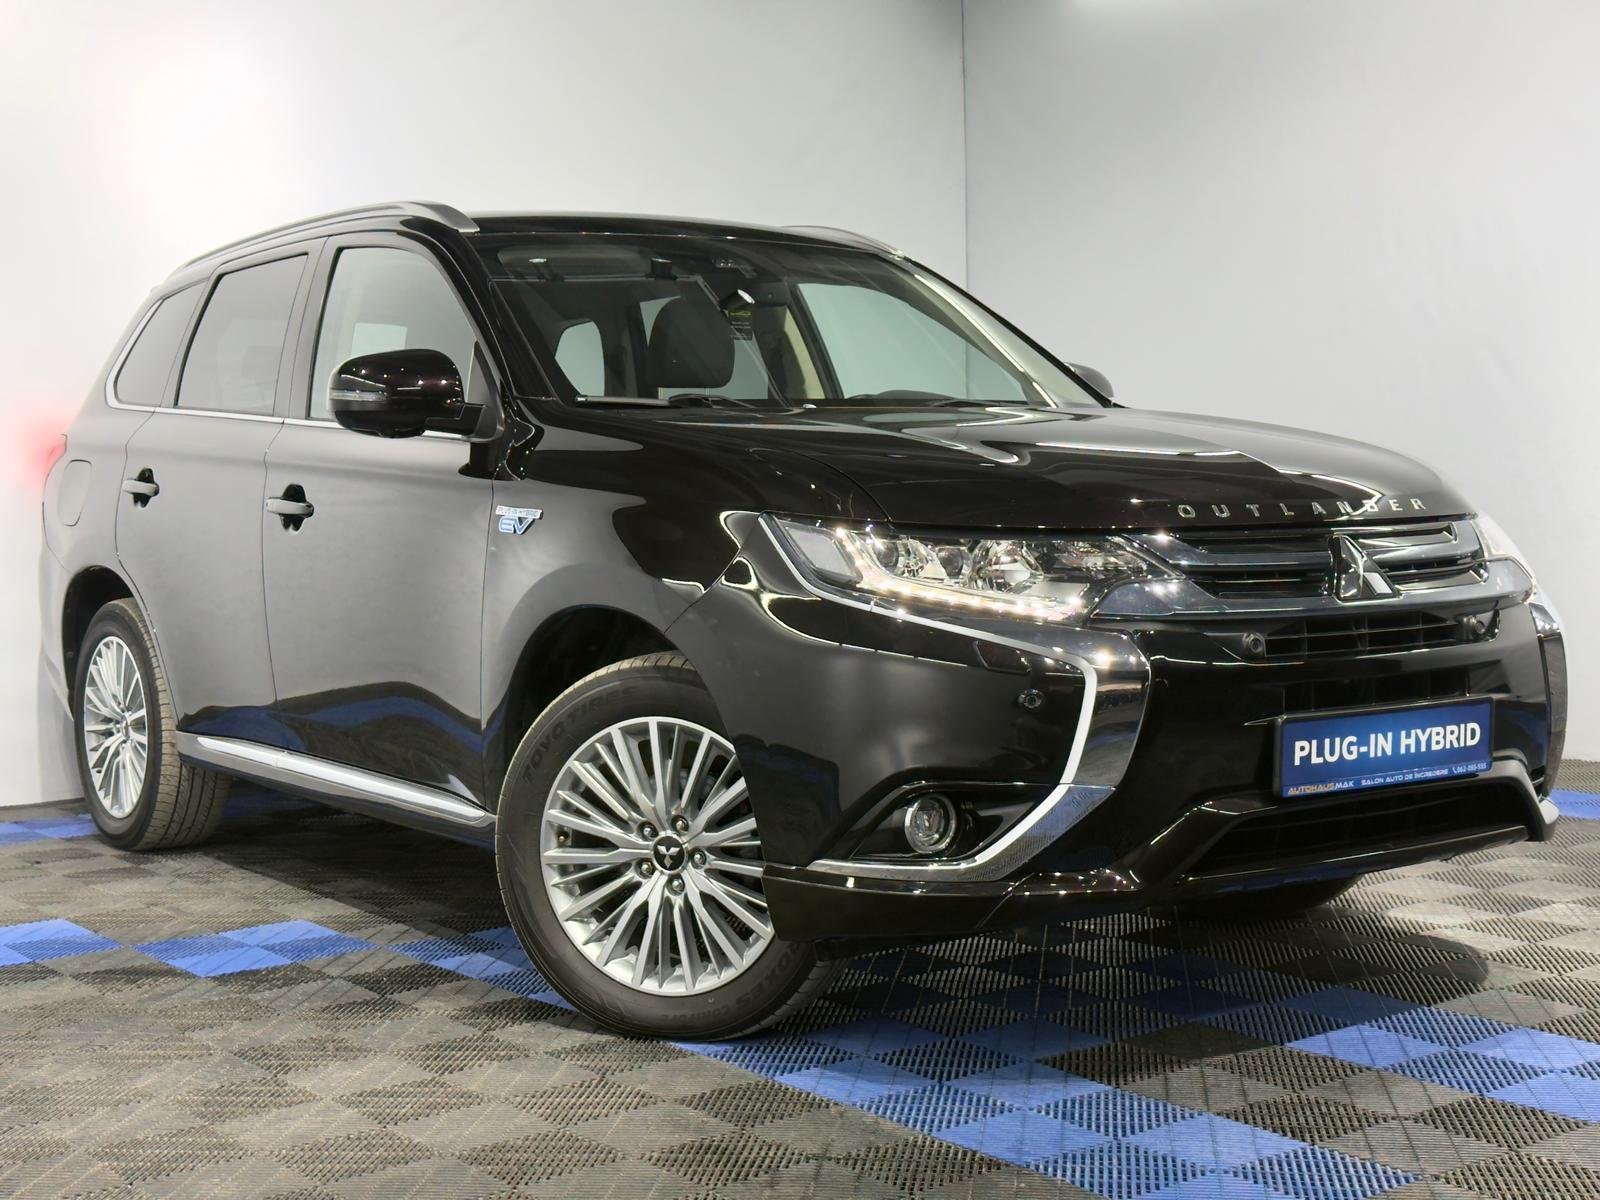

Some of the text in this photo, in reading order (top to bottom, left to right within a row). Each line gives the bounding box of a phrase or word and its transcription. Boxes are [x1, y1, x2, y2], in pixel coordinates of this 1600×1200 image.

[1177, 498, 1427, 519] OUTLANDER
[498, 515, 535, 535] EV
[1294, 722, 1482, 766] PLUG-IN HYBRID
[1360, 777, 1385, 786] SALON
[1385, 773, 1404, 783] AUTO
[1404, 773, 1414, 781] DE
